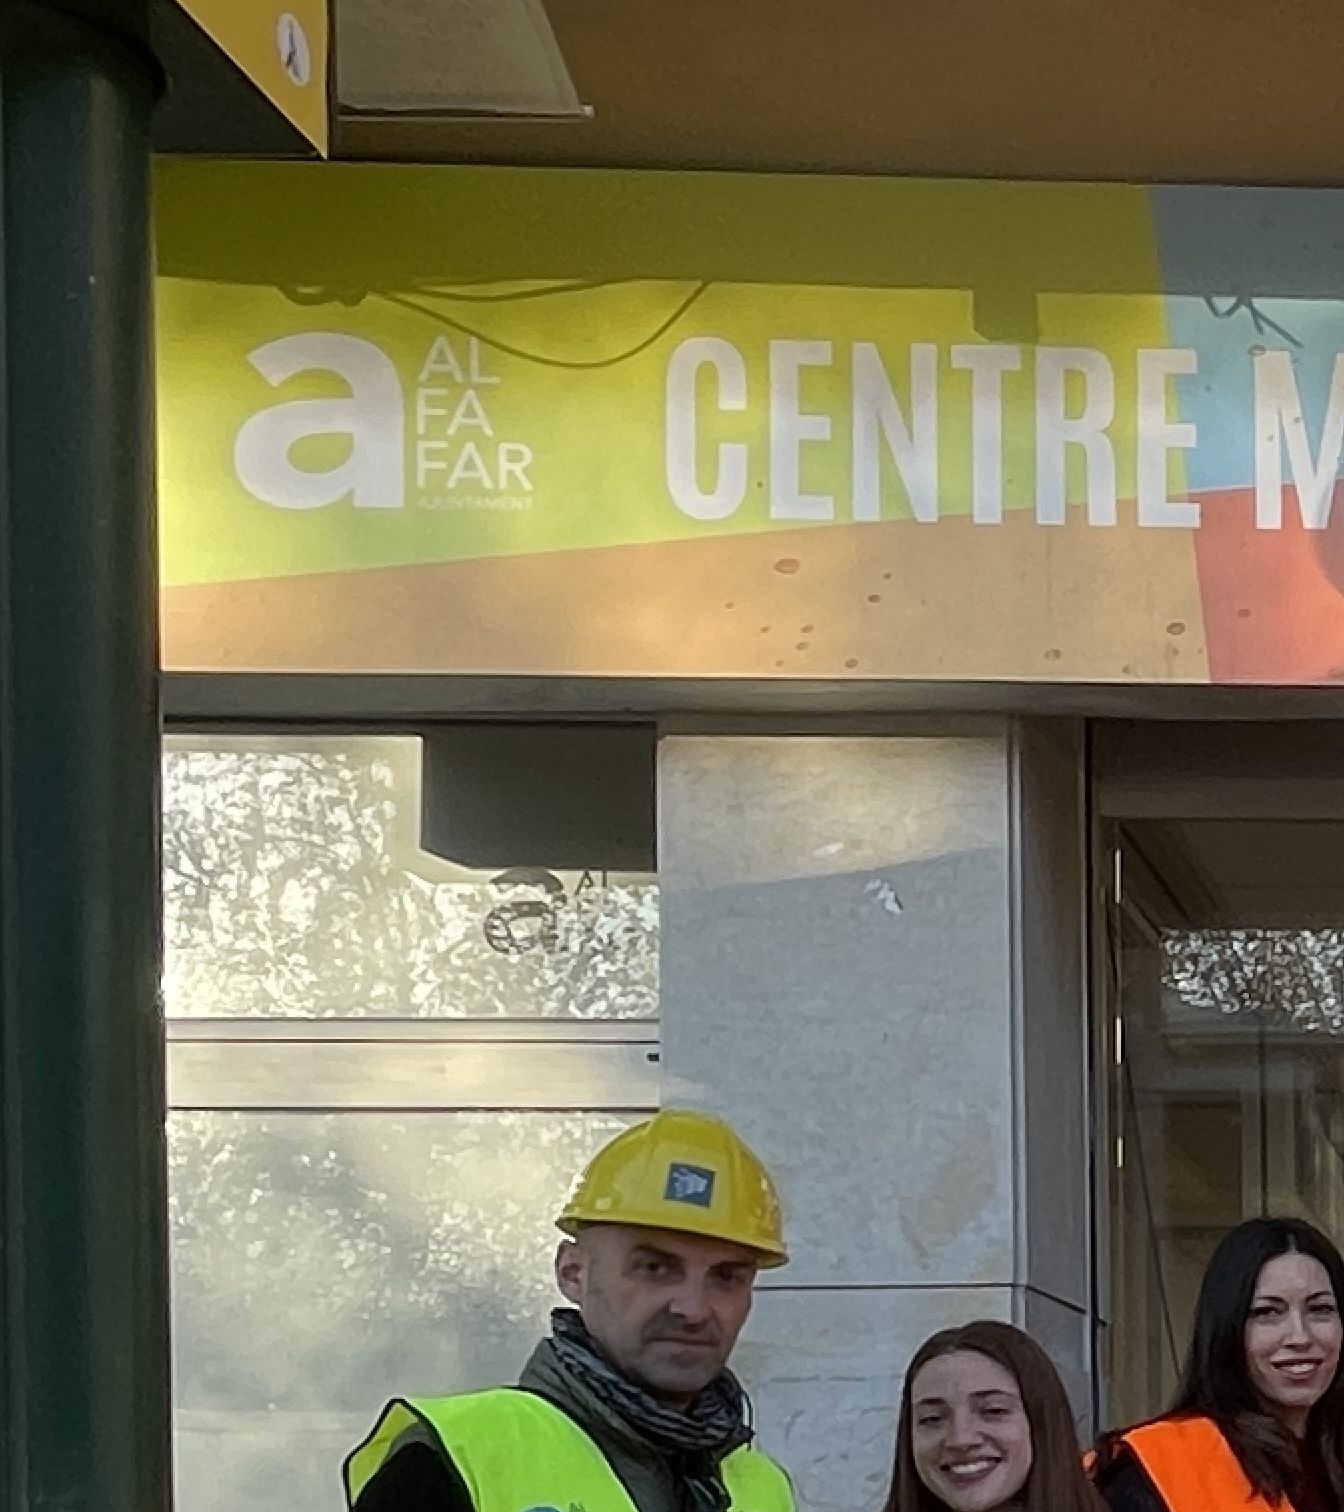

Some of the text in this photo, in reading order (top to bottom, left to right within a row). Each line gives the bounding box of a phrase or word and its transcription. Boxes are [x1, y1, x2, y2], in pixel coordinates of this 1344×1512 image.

[418, 335, 501, 384] AL
[234, 331, 404, 510] a
[416, 387, 493, 438] FA
[666, 336, 1201, 529] CENTRE
[416, 440, 533, 491] FAR
